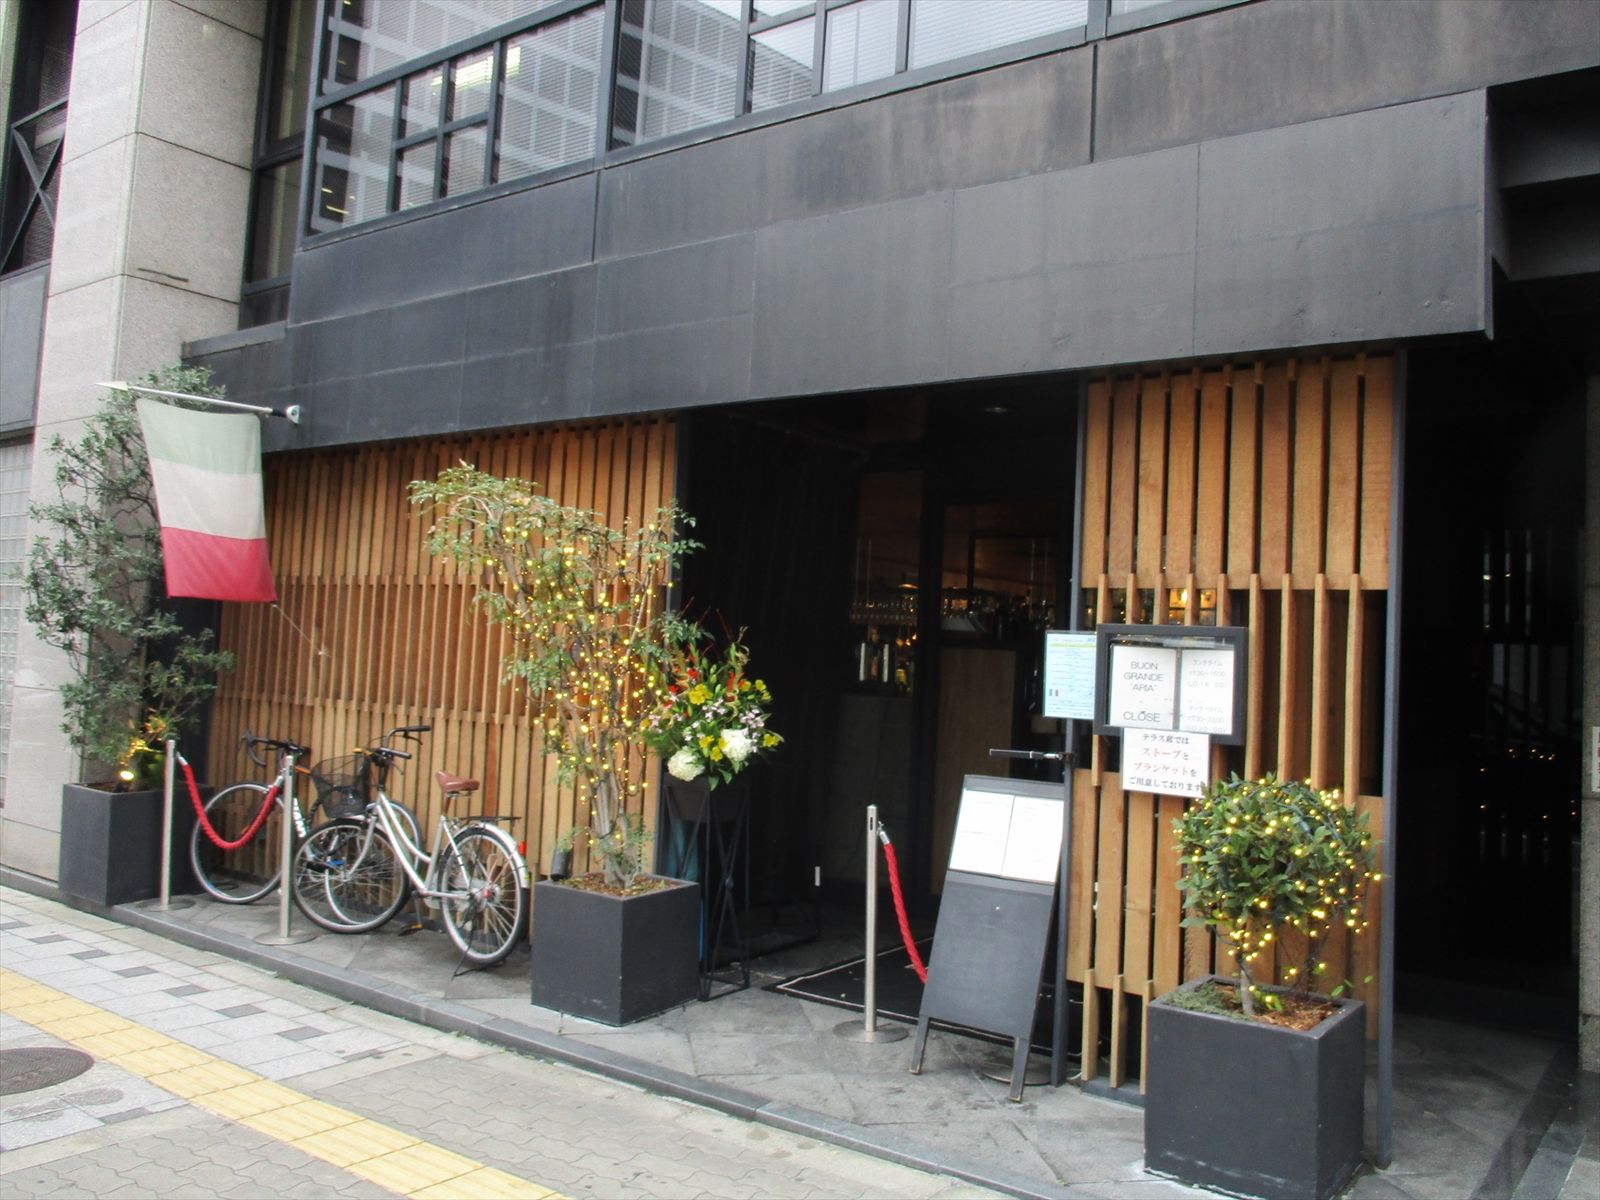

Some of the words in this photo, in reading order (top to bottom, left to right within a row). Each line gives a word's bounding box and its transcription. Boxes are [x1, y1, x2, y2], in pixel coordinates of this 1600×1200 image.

[1130, 661, 1158, 670] BUON
[1123, 671, 1165, 682] GRANDE
[1123, 711, 1161, 722] CLOSE
[1142, 733, 1190, 745] テラス席では
[1143, 747, 1190, 761] ストーブと
[1133, 761, 1198, 777] ブランケットを
